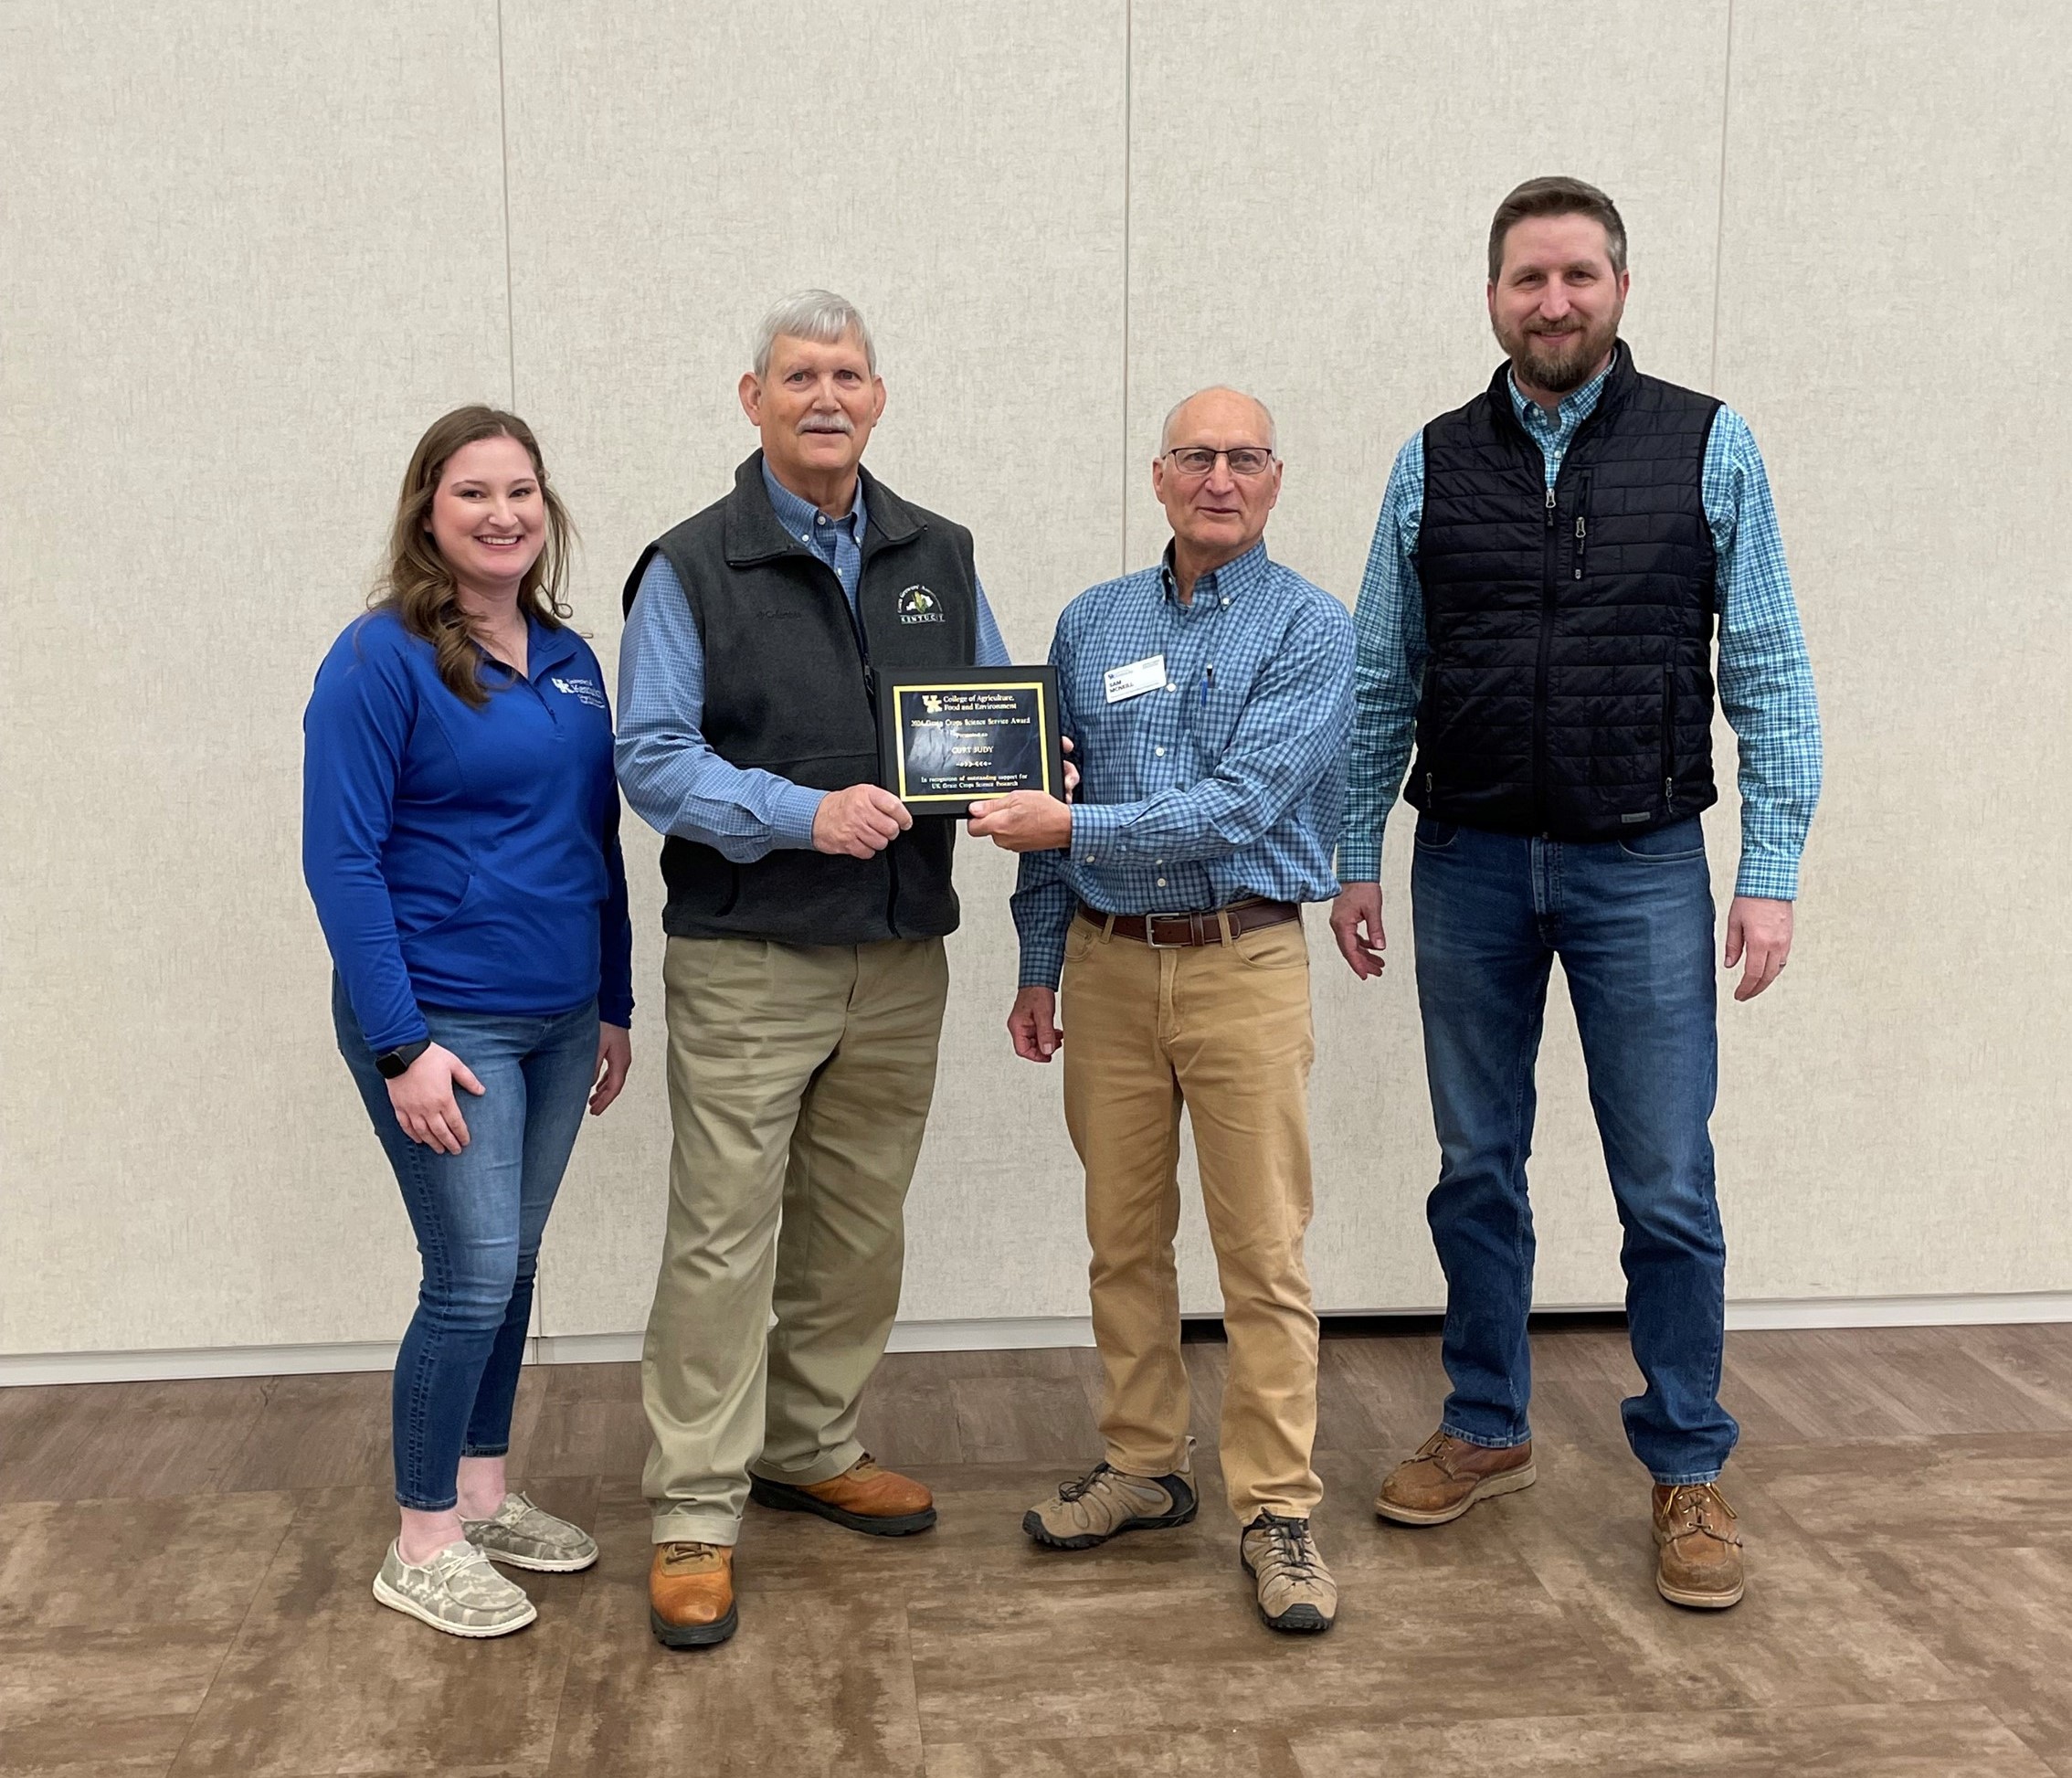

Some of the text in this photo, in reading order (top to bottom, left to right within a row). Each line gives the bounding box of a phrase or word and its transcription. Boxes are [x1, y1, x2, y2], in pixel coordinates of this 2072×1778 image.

[943, 694, 967, 704] College
[968, 694, 976, 703] of
[975, 703, 1017, 711] Environment
[945, 718, 963, 727] Crops
[988, 717, 1009, 725] Service
[1010, 716, 1031, 725] Award
[973, 746, 994, 754] JUDY
[998, 774, 1018, 782] support
